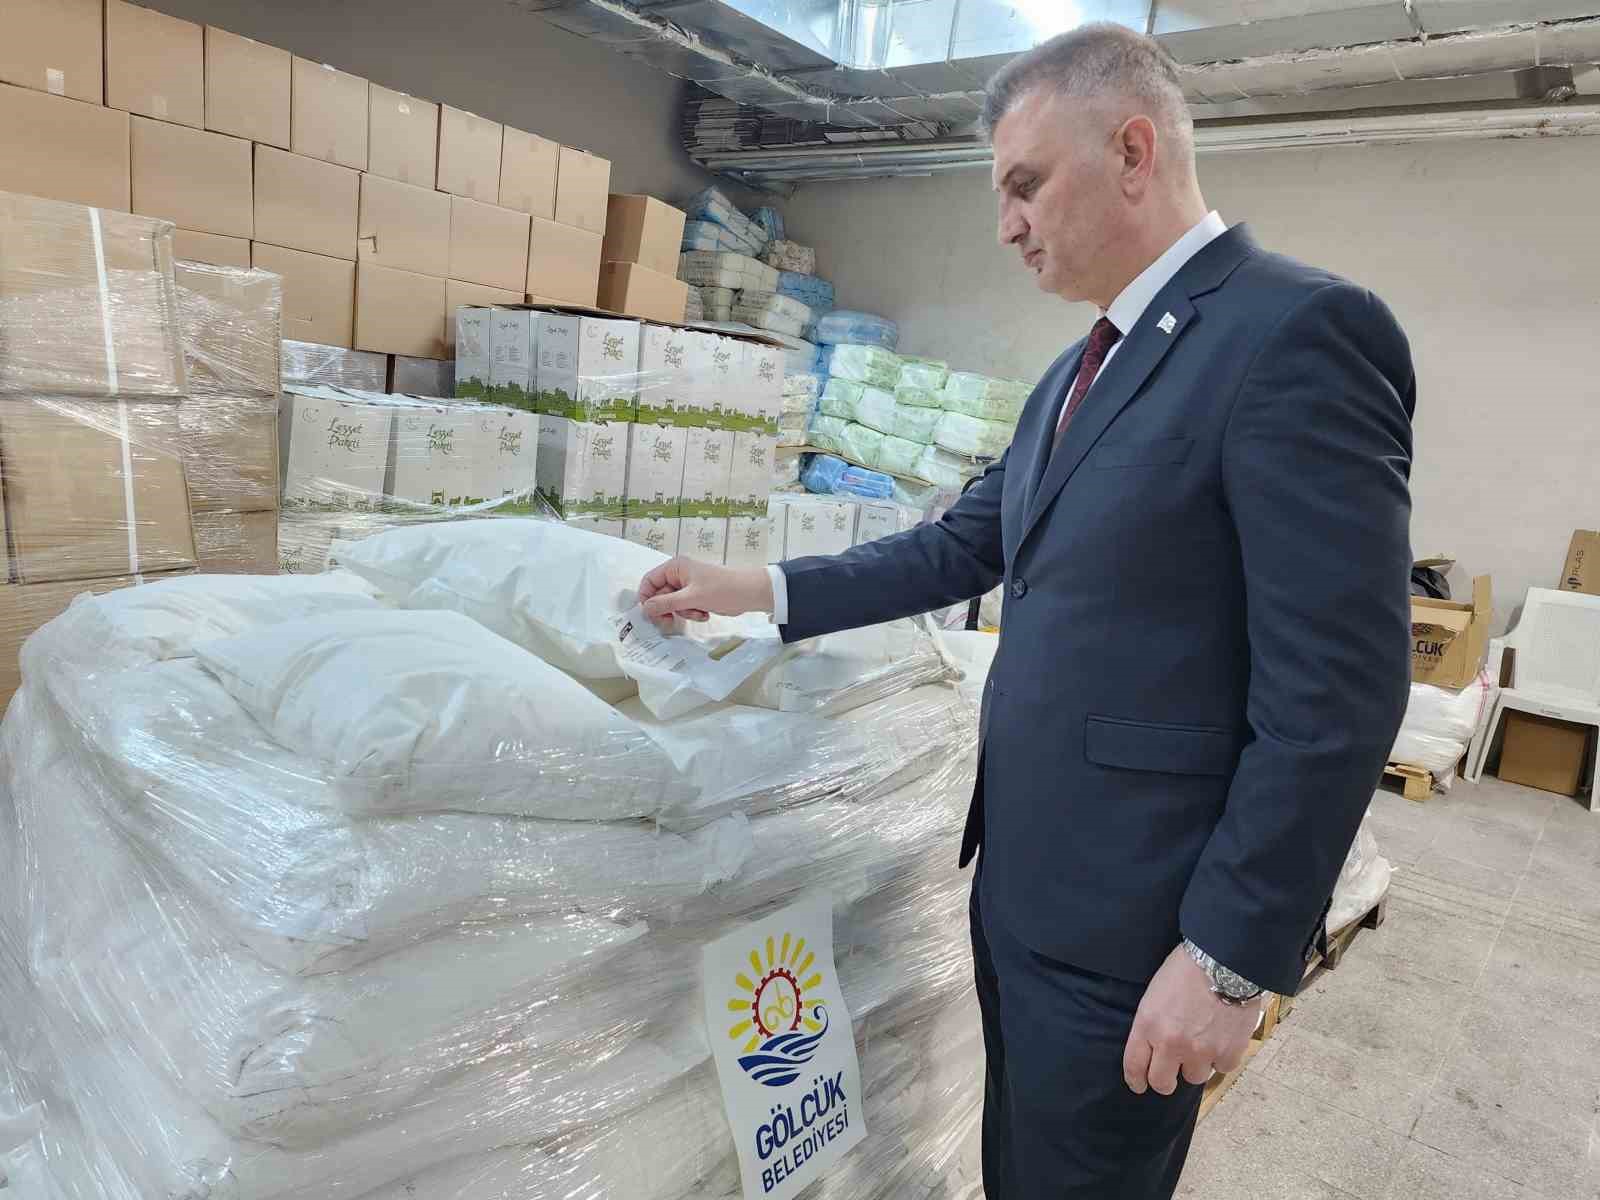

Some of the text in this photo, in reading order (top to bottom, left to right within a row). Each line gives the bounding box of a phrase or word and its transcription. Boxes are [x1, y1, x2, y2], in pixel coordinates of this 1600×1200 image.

[327, 416, 364, 437] Lezzet
[755, 1071, 847, 1160] GÖLCÜK
[761, 1103, 848, 1193] BELEDİYESİ
